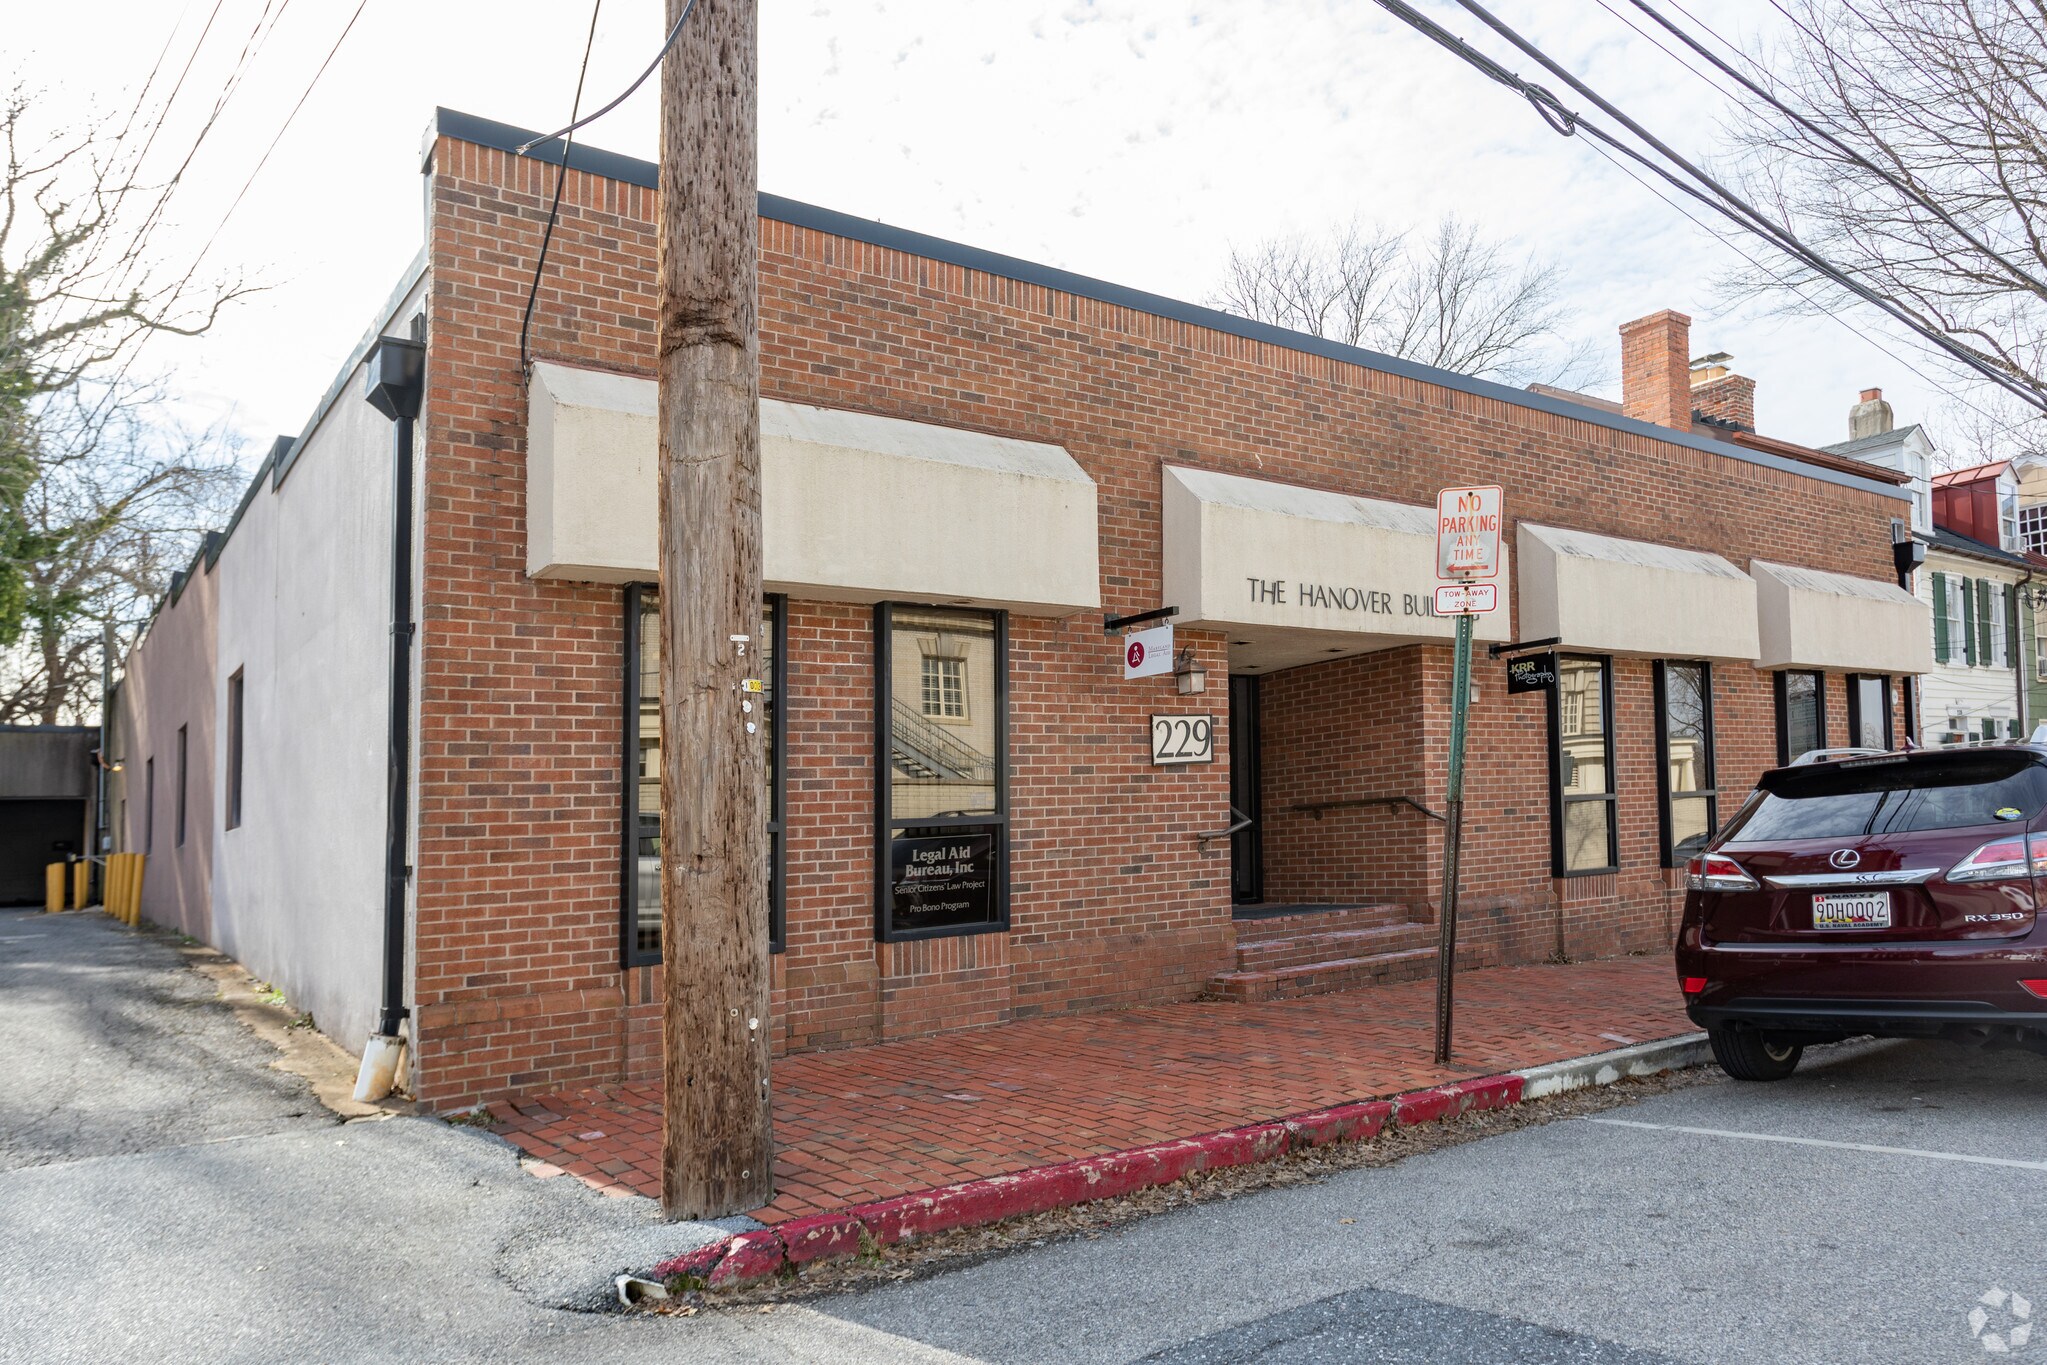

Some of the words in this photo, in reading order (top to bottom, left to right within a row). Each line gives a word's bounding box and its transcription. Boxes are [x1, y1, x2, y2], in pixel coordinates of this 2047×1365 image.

[1458, 495, 1482, 513] NO
[1442, 514, 1497, 534] PARKING
[1456, 534, 1481, 547] ANY
[1454, 548, 1483, 561] TIME
[1246, 577, 1287, 605] THE
[1299, 583, 1393, 615] HANOVER
[1454, 600, 1477, 608] ZONE
[1511, 661, 1536, 674] KRR
[1155, 719, 1211, 759] 229
[912, 847, 947, 864] Legal
[948, 846, 971, 859] Aid
[905, 864, 953, 877] Bureau,
[955, 861, 975, 874] Inc
[894, 884, 918, 895] Senior
[917, 882, 947, 893] Citizens'
[946, 882, 961, 891] Law
[962, 880, 986, 890] Project
[910, 904, 922, 913] Pro
[922, 903, 941, 911] Bono
[941, 901, 970, 911] Program
[1964, 914, 1989, 922] RX
[1989, 912, 2024, 921] 350
